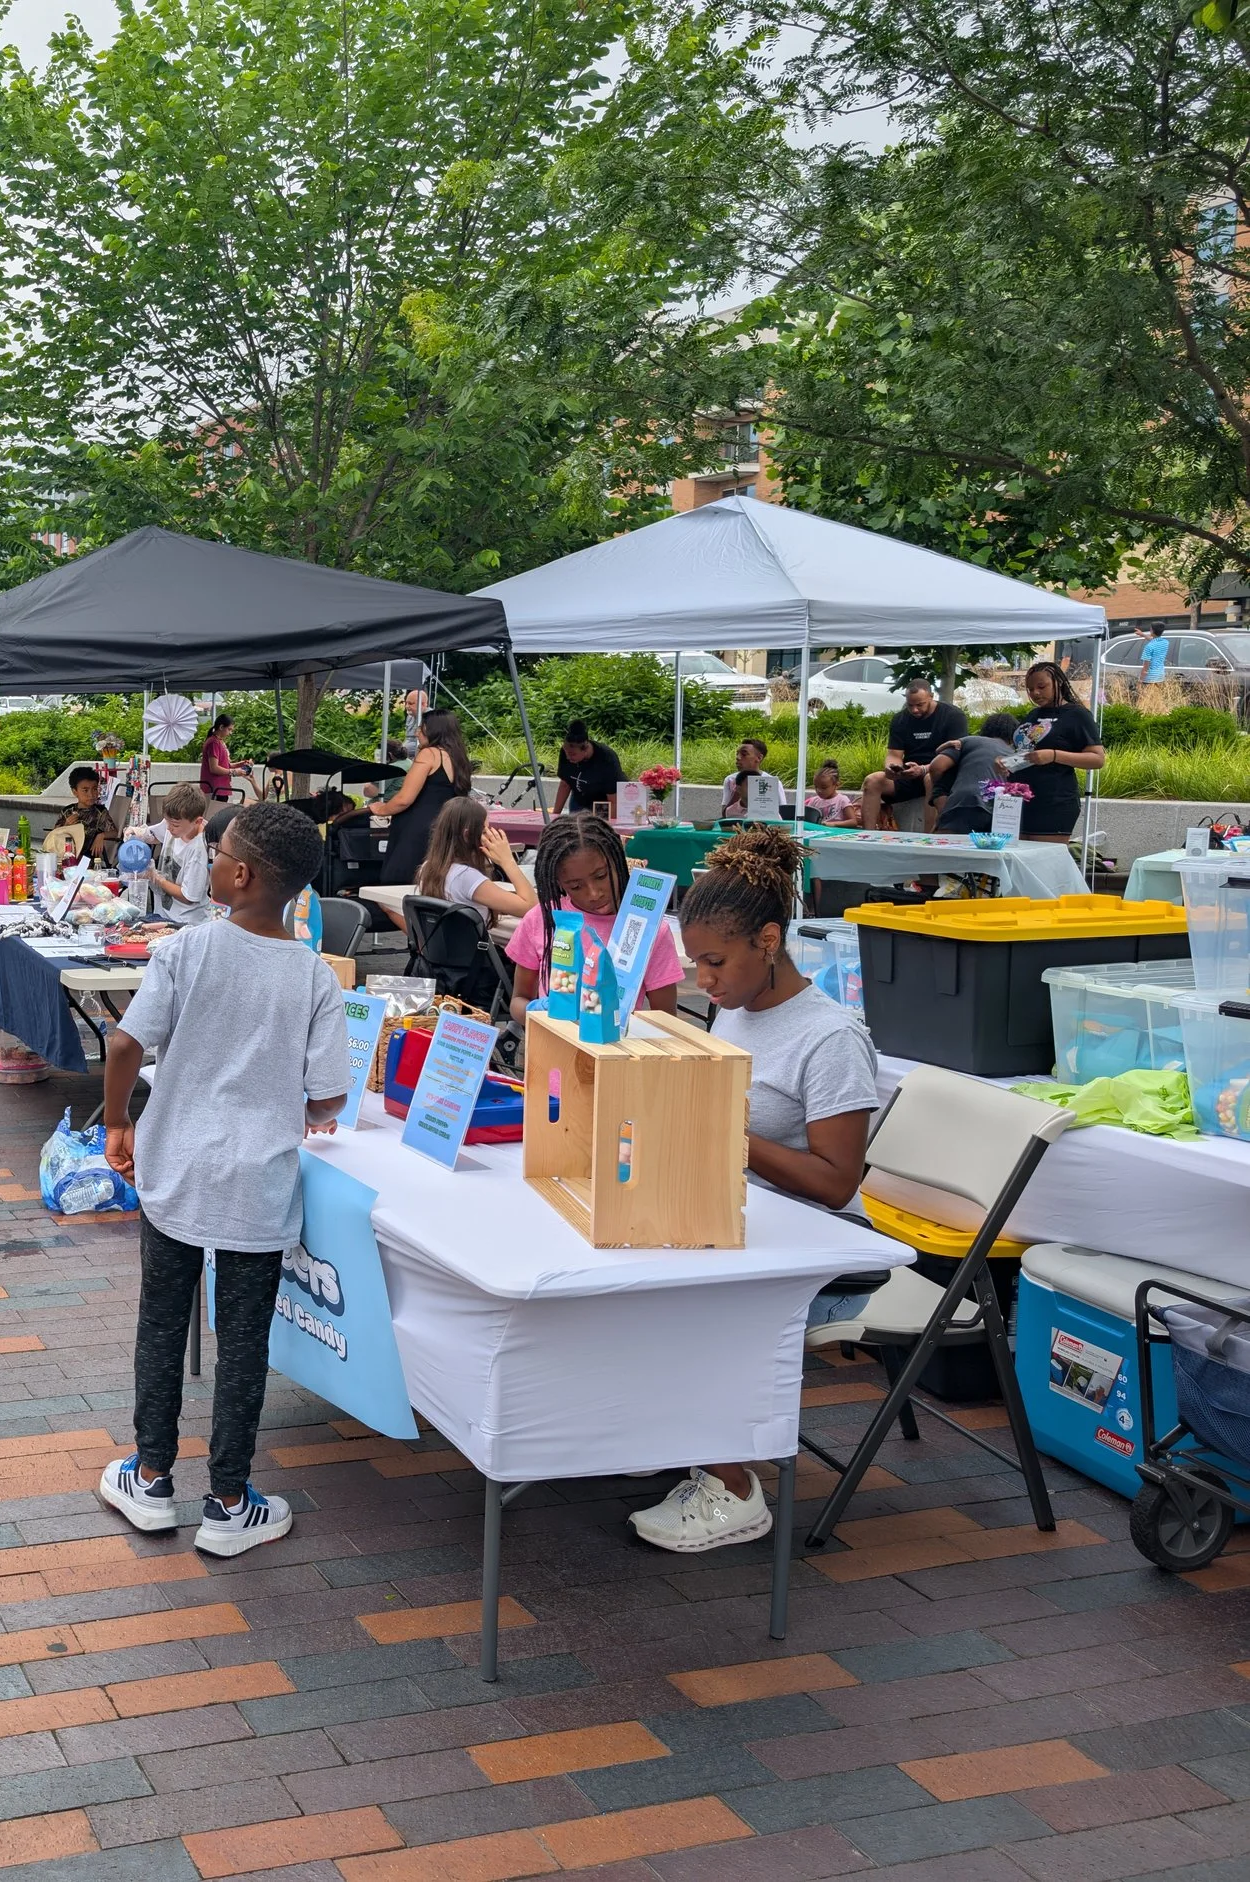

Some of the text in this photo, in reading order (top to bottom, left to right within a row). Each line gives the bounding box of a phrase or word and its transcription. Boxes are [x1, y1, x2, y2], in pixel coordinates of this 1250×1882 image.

[348, 1036, 369, 1051] $6.00
[350, 1055, 363, 1069] .00
[293, 1303, 347, 1362] Candy
[1117, 1373, 1128, 1383] 60
[1116, 1390, 1127, 1400] 94
[1097, 1428, 1126, 1450] Coleman
